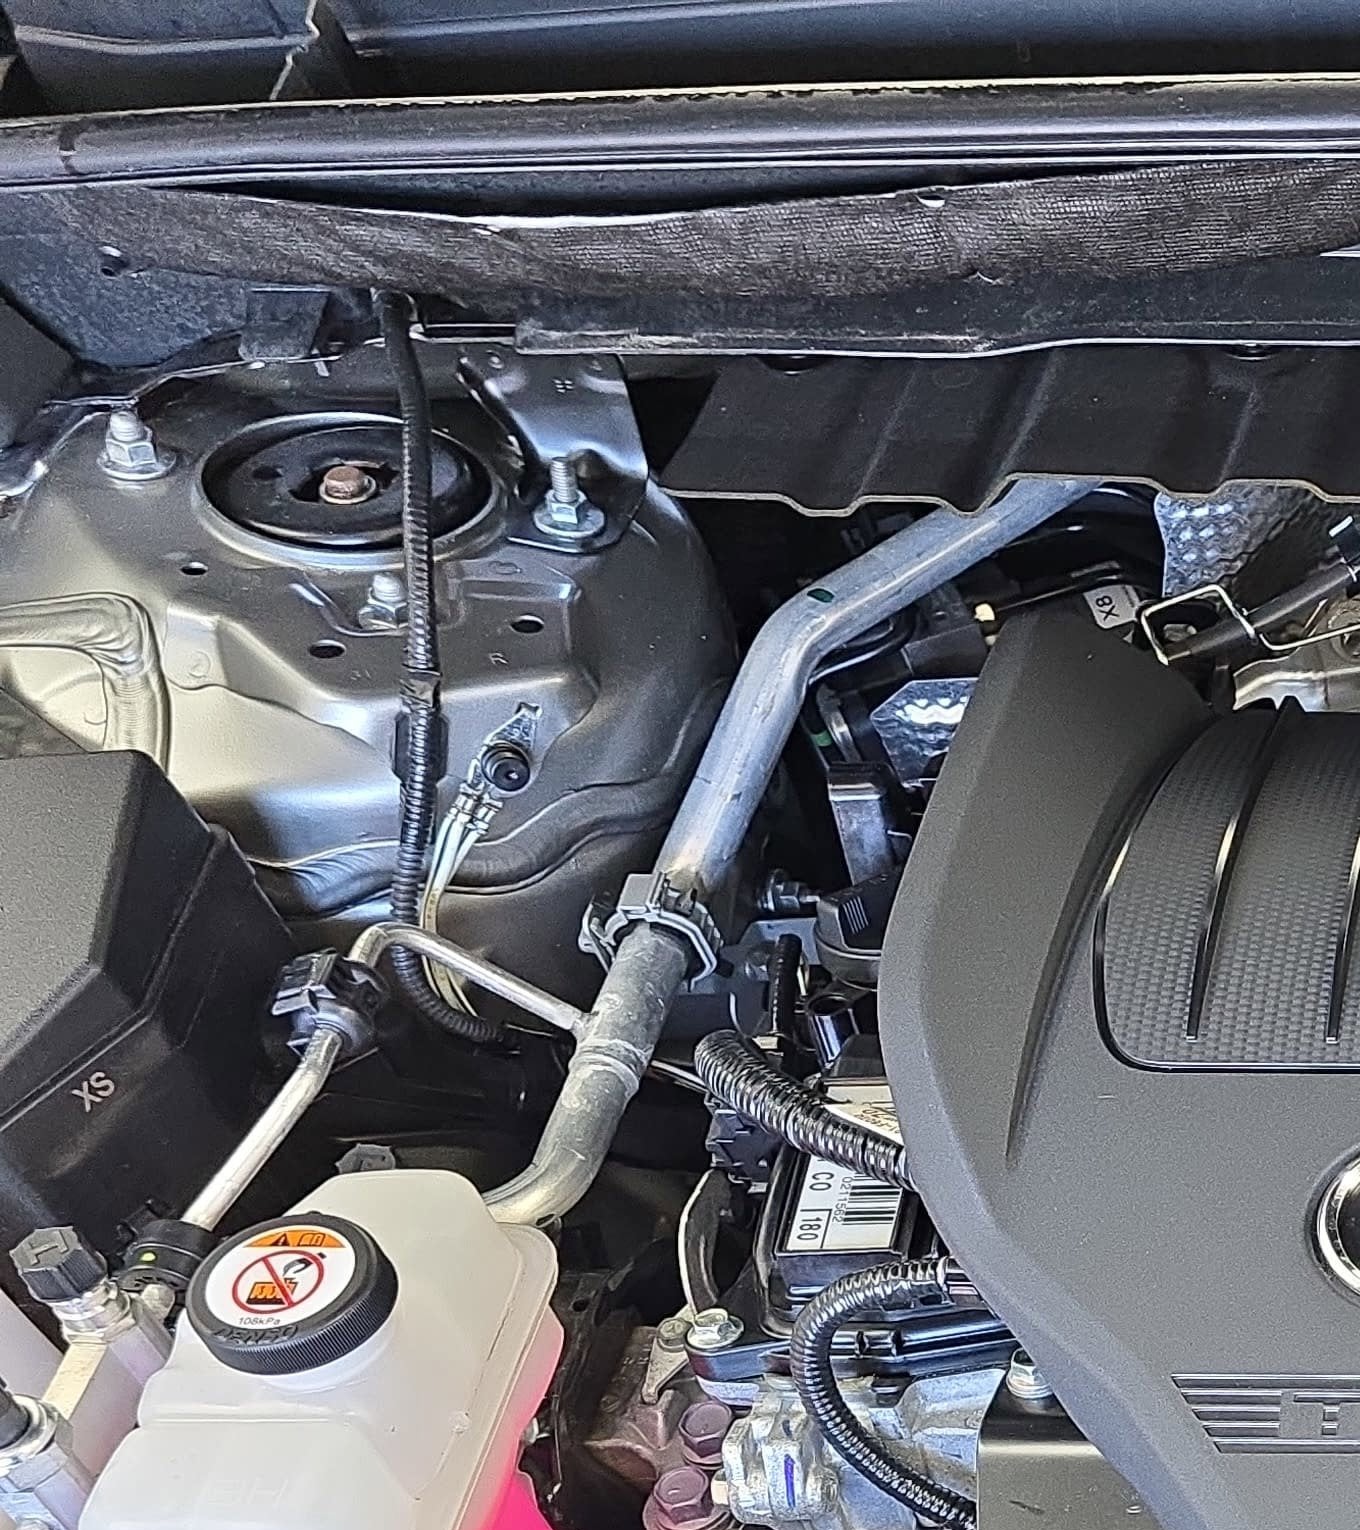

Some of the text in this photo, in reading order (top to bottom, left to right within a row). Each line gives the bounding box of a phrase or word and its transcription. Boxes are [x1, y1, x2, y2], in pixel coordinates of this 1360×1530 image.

[71, 1071, 115, 1112] XS
[831, 1176, 854, 1223] 0211562
[797, 1217, 823, 1240] 180
[238, 1315, 281, 1327] 108kPa
